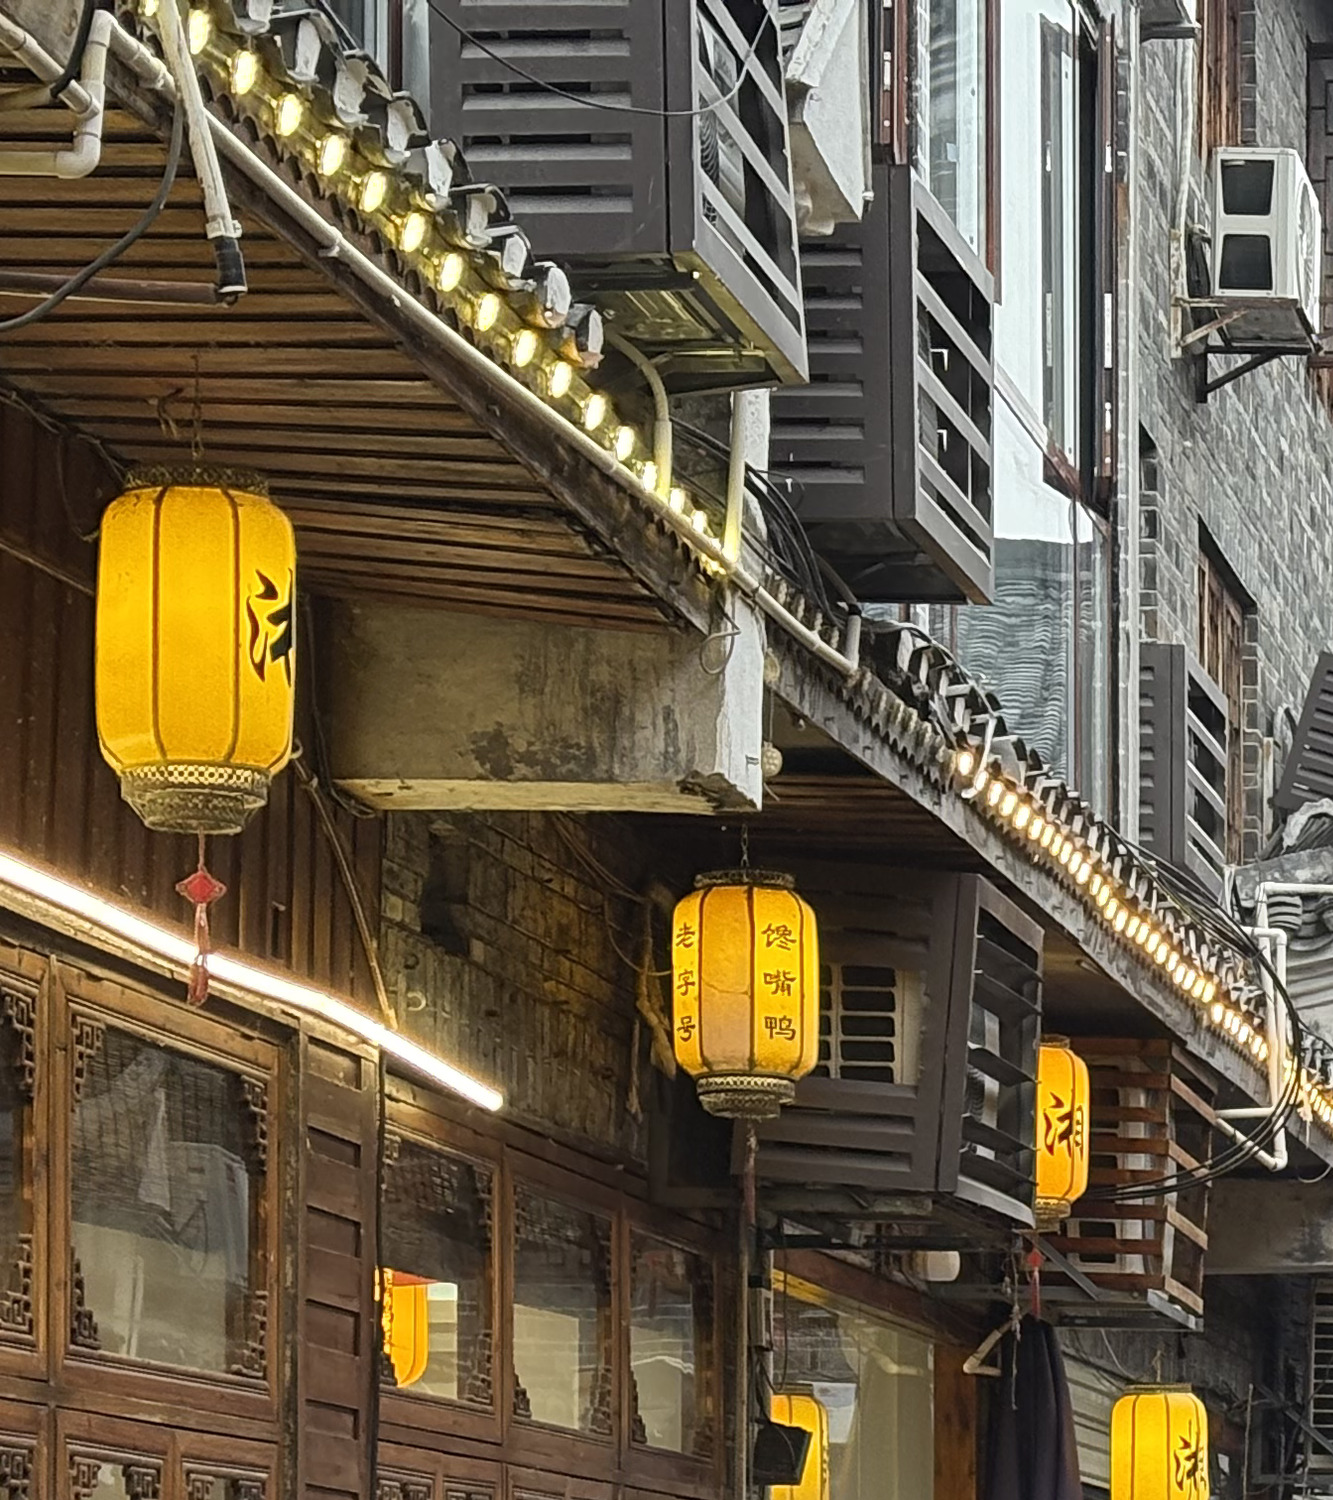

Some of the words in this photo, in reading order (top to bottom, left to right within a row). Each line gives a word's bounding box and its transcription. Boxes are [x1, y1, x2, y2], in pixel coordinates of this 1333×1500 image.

[675, 922, 696, 1042] 老字号
[761, 923, 797, 1041] 馋嘴鸭
[1043, 1089, 1084, 1161] 湘
